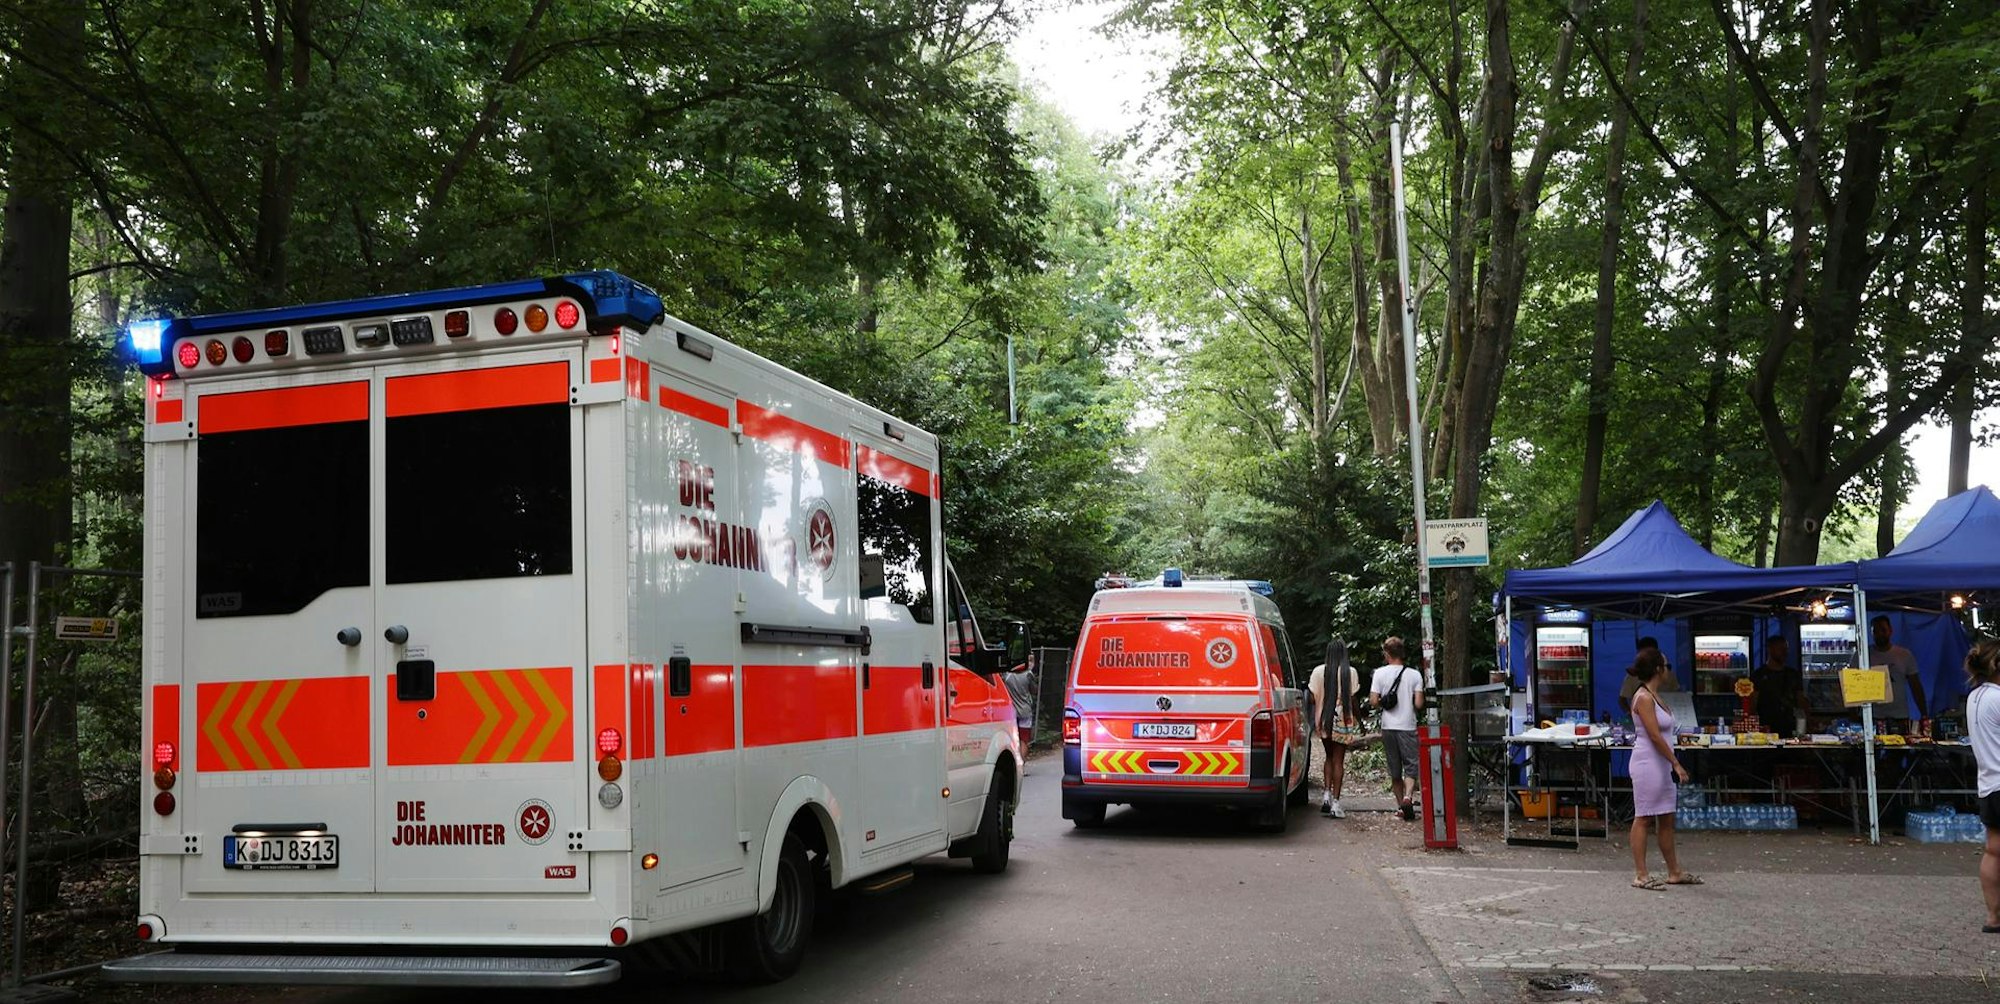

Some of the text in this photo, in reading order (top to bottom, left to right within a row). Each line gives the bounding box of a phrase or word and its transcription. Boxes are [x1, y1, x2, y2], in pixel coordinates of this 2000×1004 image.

[679, 459, 715, 511] DIE
[1426, 521, 1483, 529] PRIVATPARKPLATZ
[207, 596, 235, 607] WAS
[1101, 638, 1123, 651] DIE
[1097, 653, 1189, 667] JOHANNITER
[1142, 725, 1190, 735] K DJ 824
[397, 801, 425, 822] DIE
[392, 824, 505, 846] JOHANNITER
[236, 840, 248, 861] K
[260, 840, 284, 861] DJ
[288, 840, 335, 861] 8313
[549, 867, 571, 876] WAS
